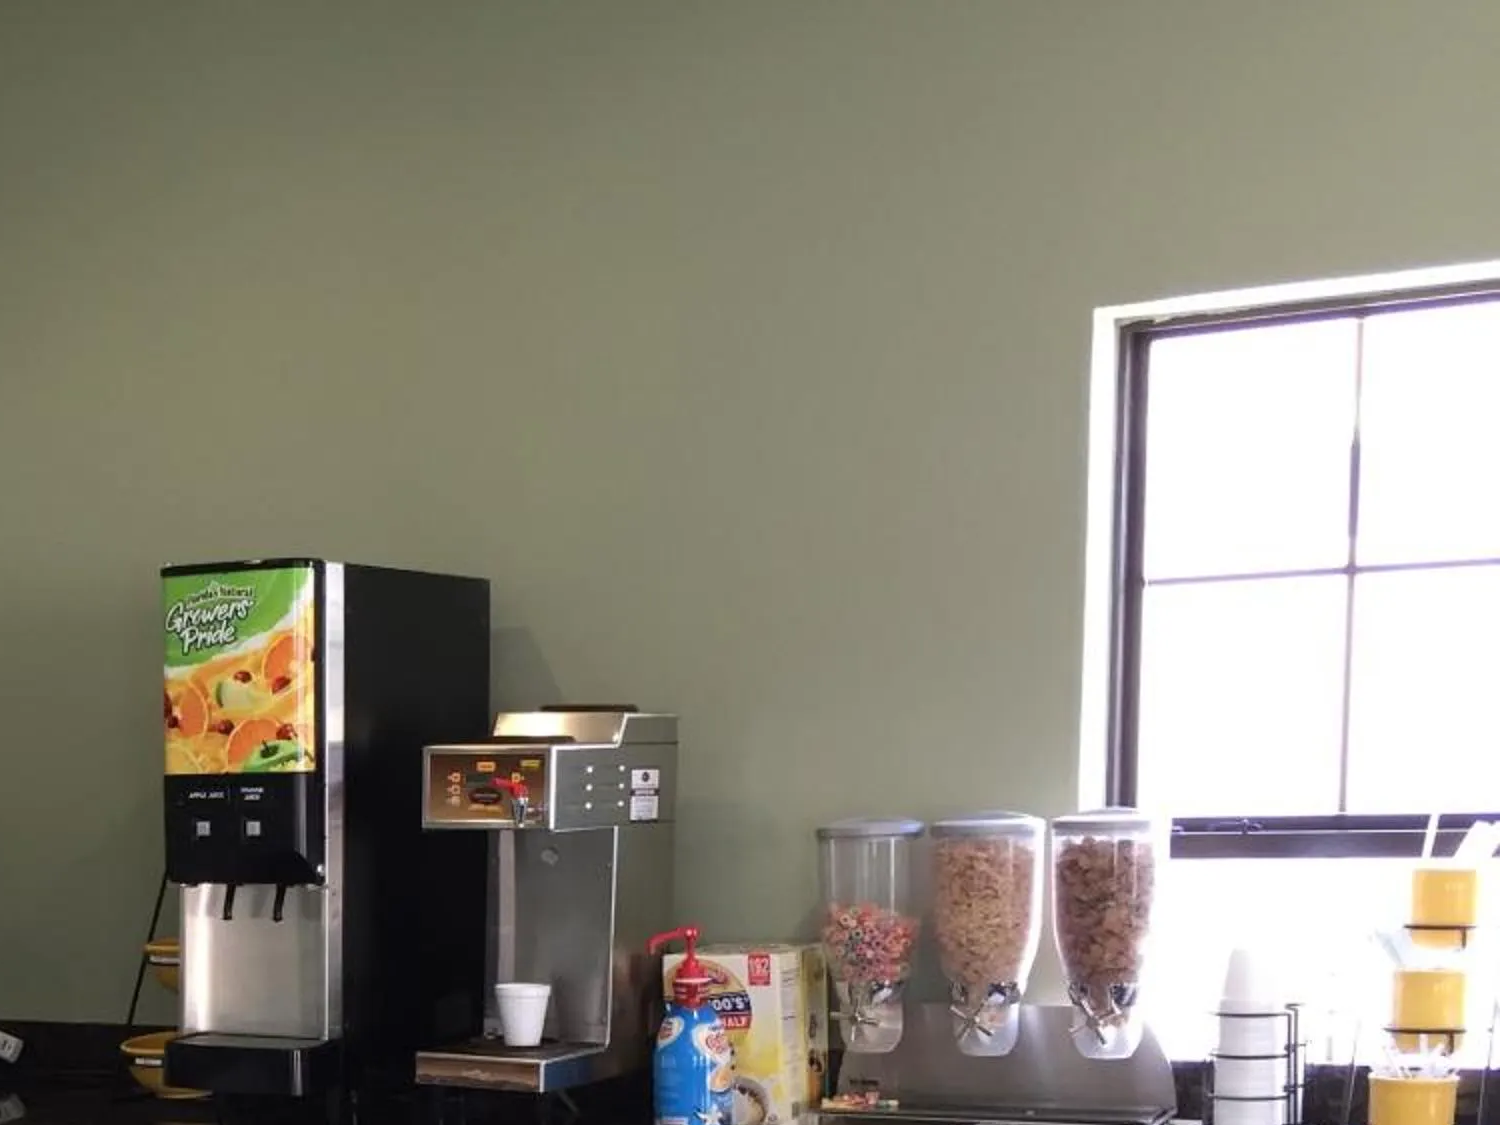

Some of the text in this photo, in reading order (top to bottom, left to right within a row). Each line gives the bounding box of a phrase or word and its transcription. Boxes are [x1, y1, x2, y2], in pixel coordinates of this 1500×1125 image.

[180, 619, 235, 653] Pride
[749, 957, 769, 977] 192
[708, 996, 746, 1011] OO'S
